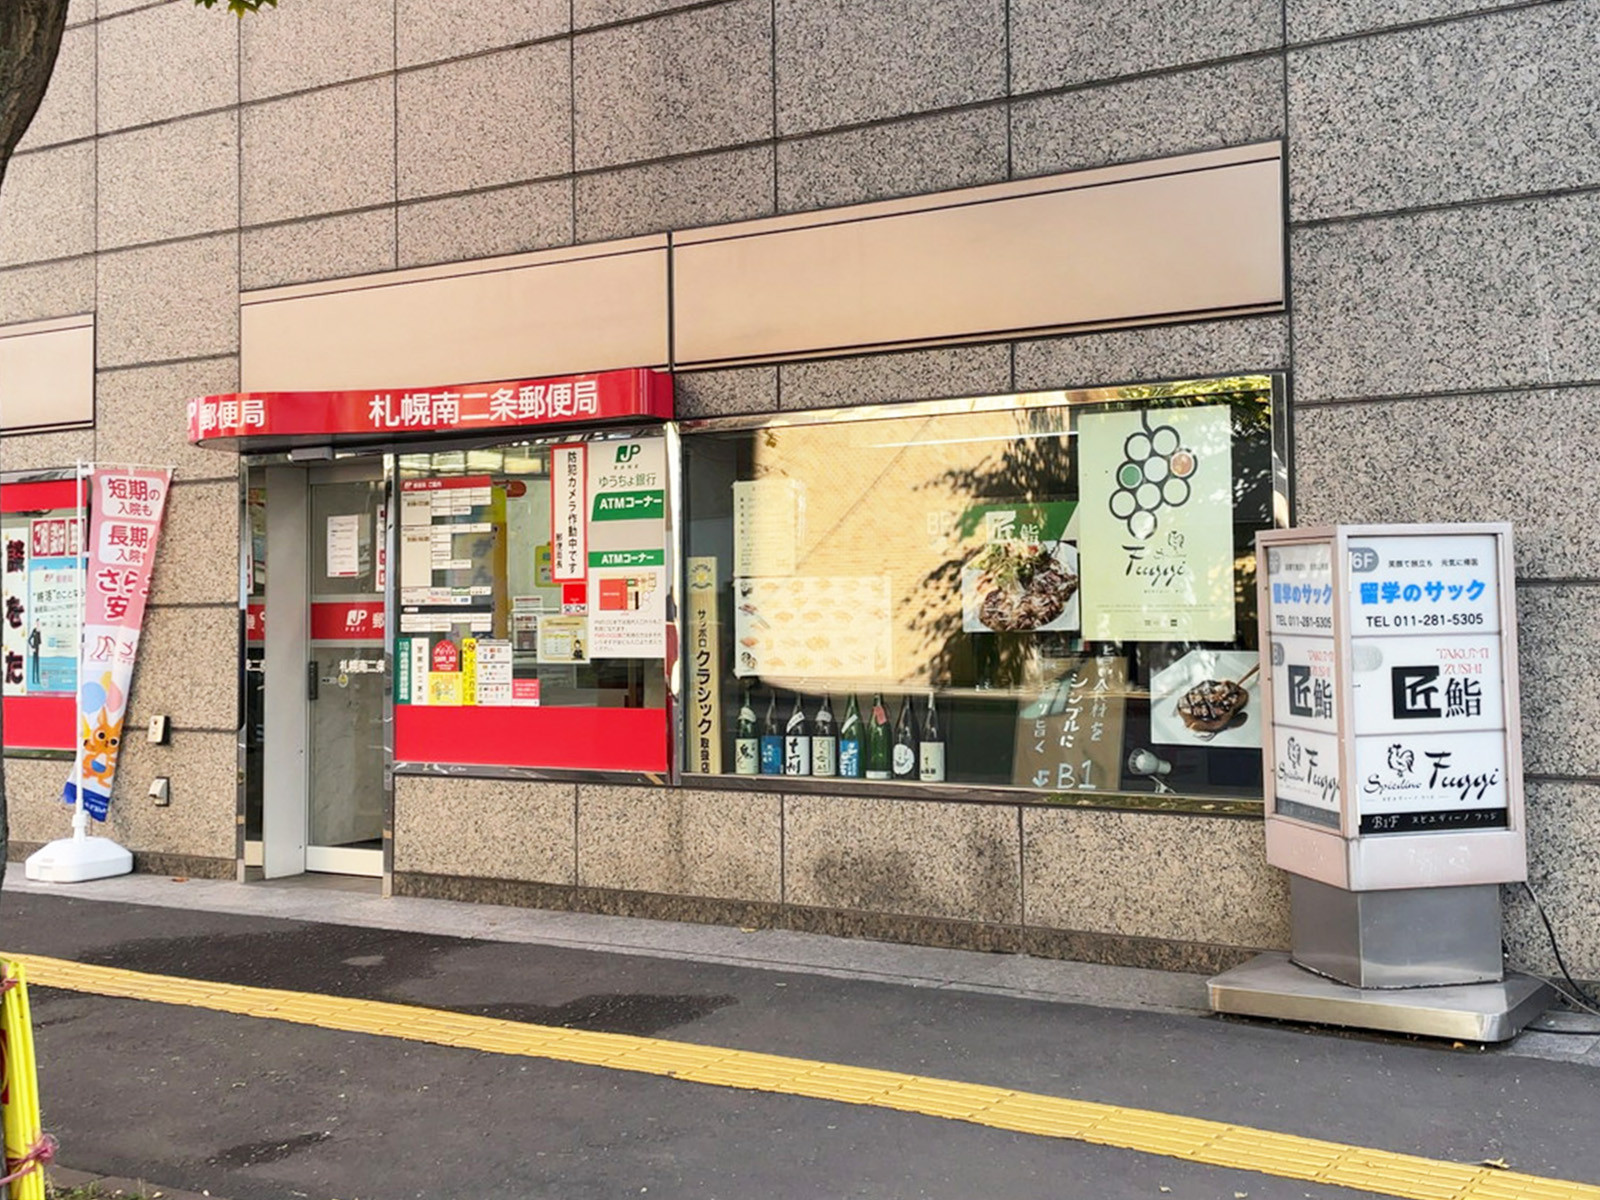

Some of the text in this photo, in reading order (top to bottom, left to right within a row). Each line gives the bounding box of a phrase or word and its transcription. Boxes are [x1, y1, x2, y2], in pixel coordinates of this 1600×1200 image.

[368, 380, 598, 429] 札幌南二条郵便局
[108, 478, 160, 501] 短期の
[598, 472, 656, 488] ゆうちょ銀行
[118, 502, 153, 517] 入院も
[567, 451, 578, 574] 防犯カメラ作動中です
[599, 495, 662, 510] ATMコーナー
[985, 510, 1039, 545] 匠鮨
[601, 552, 654, 565] ATMコーナー
[1352, 552, 1374, 569] 6F
[1273, 583, 1332, 605] 留学のサック
[1360, 579, 1486, 604] 留学のサック
[1366, 613, 1484, 627] TEL 011-281-5305
[1436, 648, 1489, 660] TAKUMI
[1444, 663, 1482, 675] ZUSHI
[1287, 664, 1333, 719] 匠鮨
[1391, 664, 1482, 719] 匠鮨
[1060, 673, 1089, 748] シンプルに
[1057, 759, 1096, 790] B1
[1424, 751, 1499, 801] Fuggi
